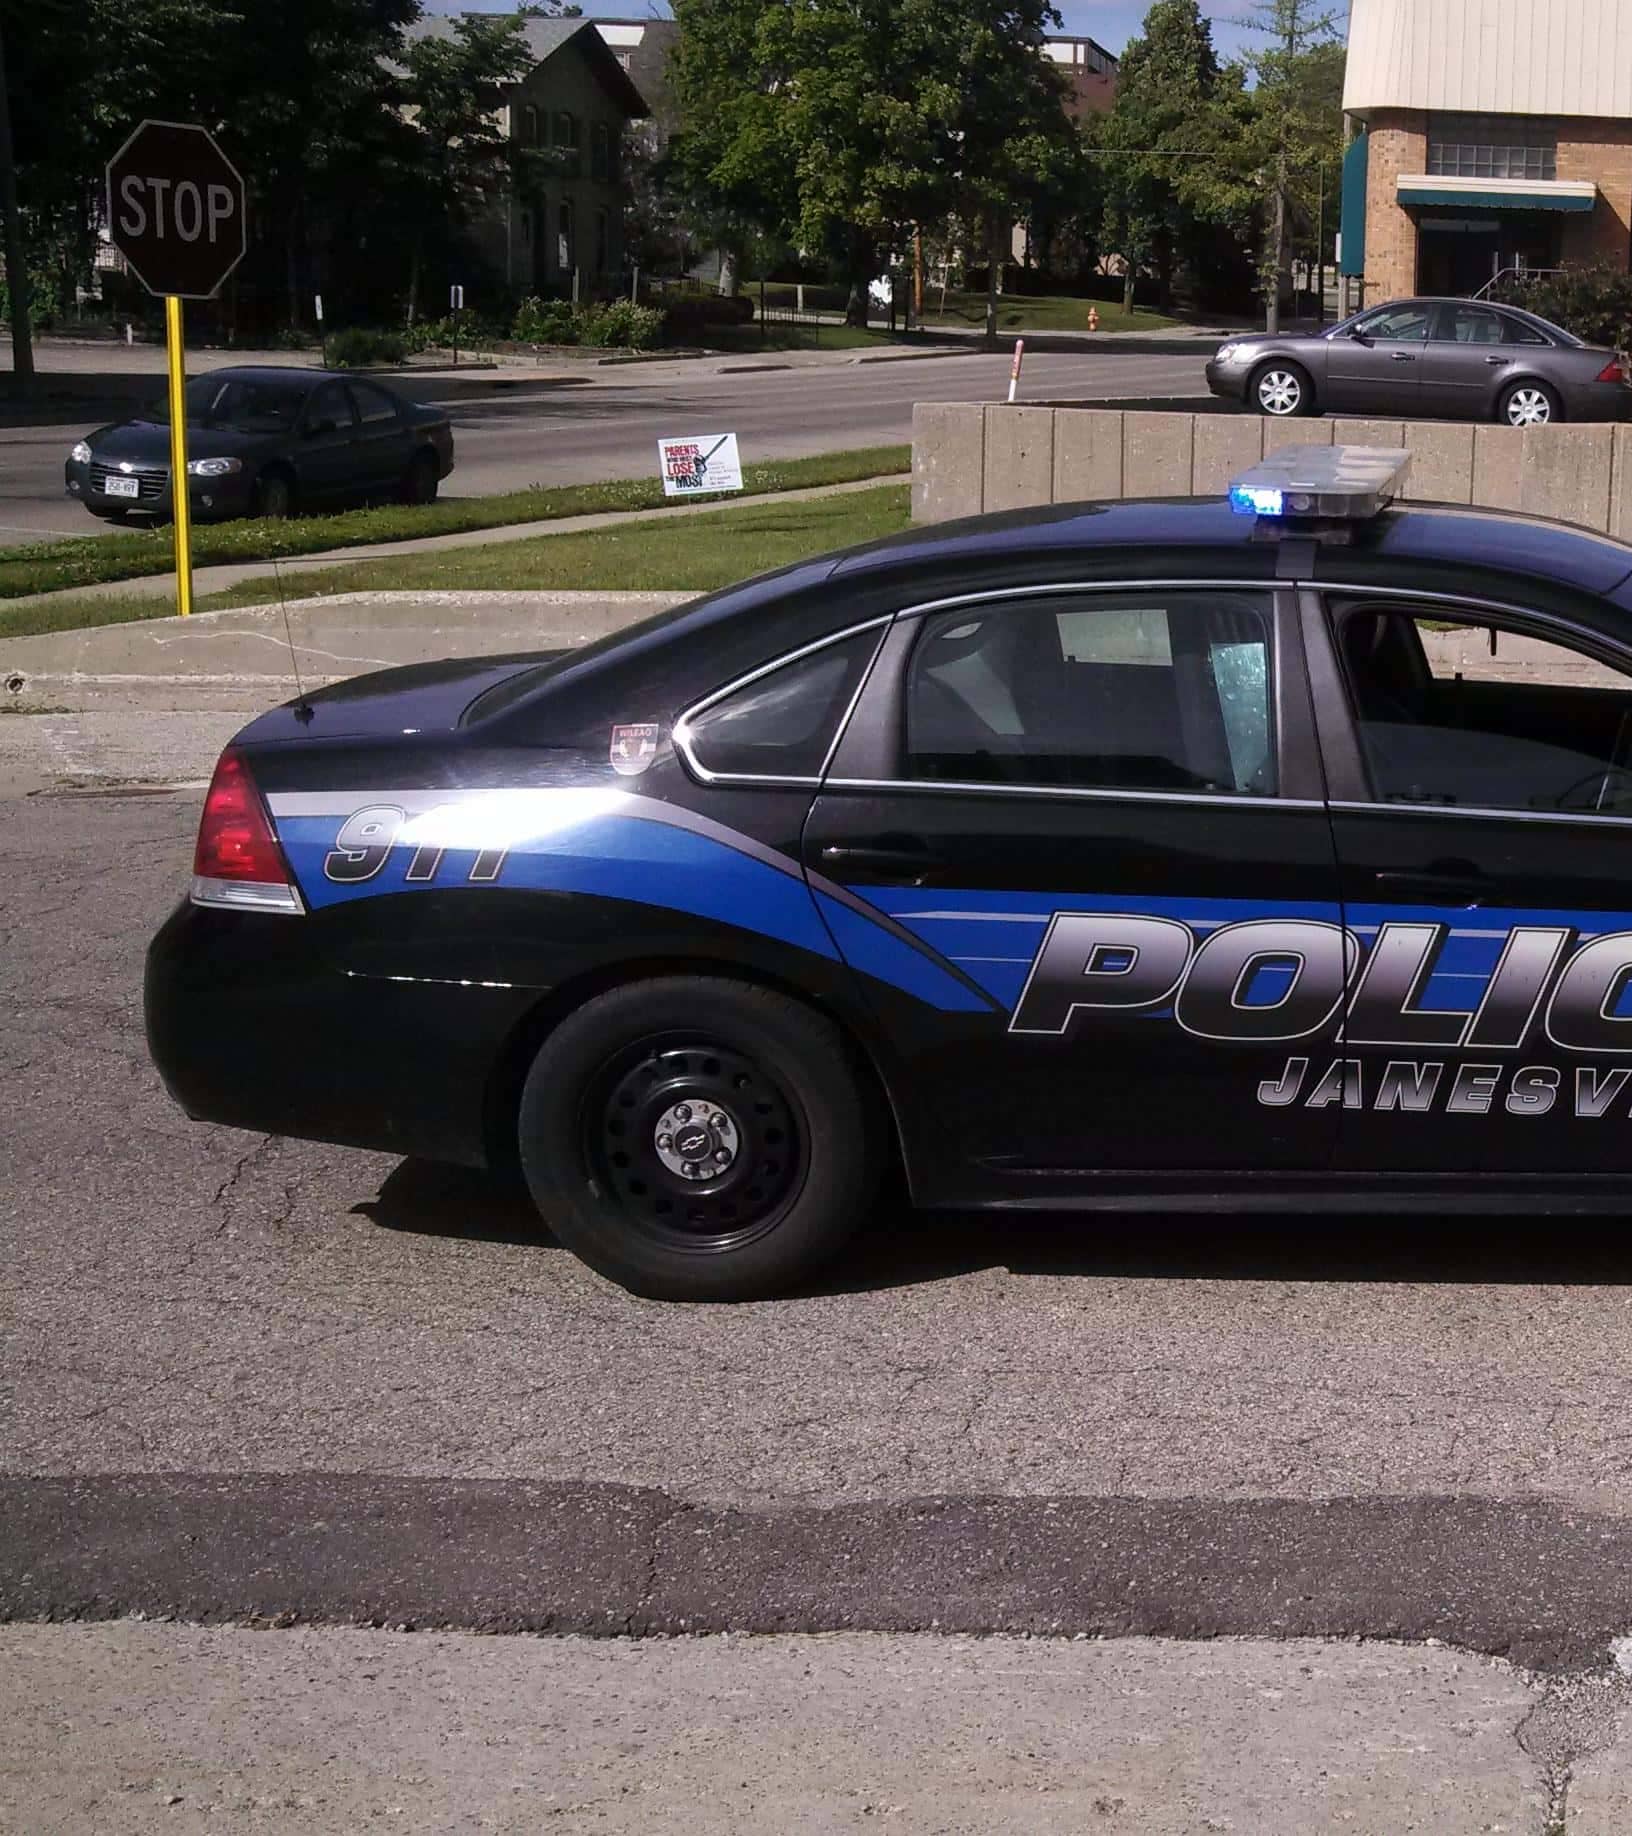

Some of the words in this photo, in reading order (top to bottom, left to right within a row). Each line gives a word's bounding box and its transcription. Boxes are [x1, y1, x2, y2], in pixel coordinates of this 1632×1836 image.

[119, 175, 235, 244] STOP
[664, 444, 700, 457] PARENTS
[667, 461, 695, 475] LOSE
[675, 475, 703, 488] MOST
